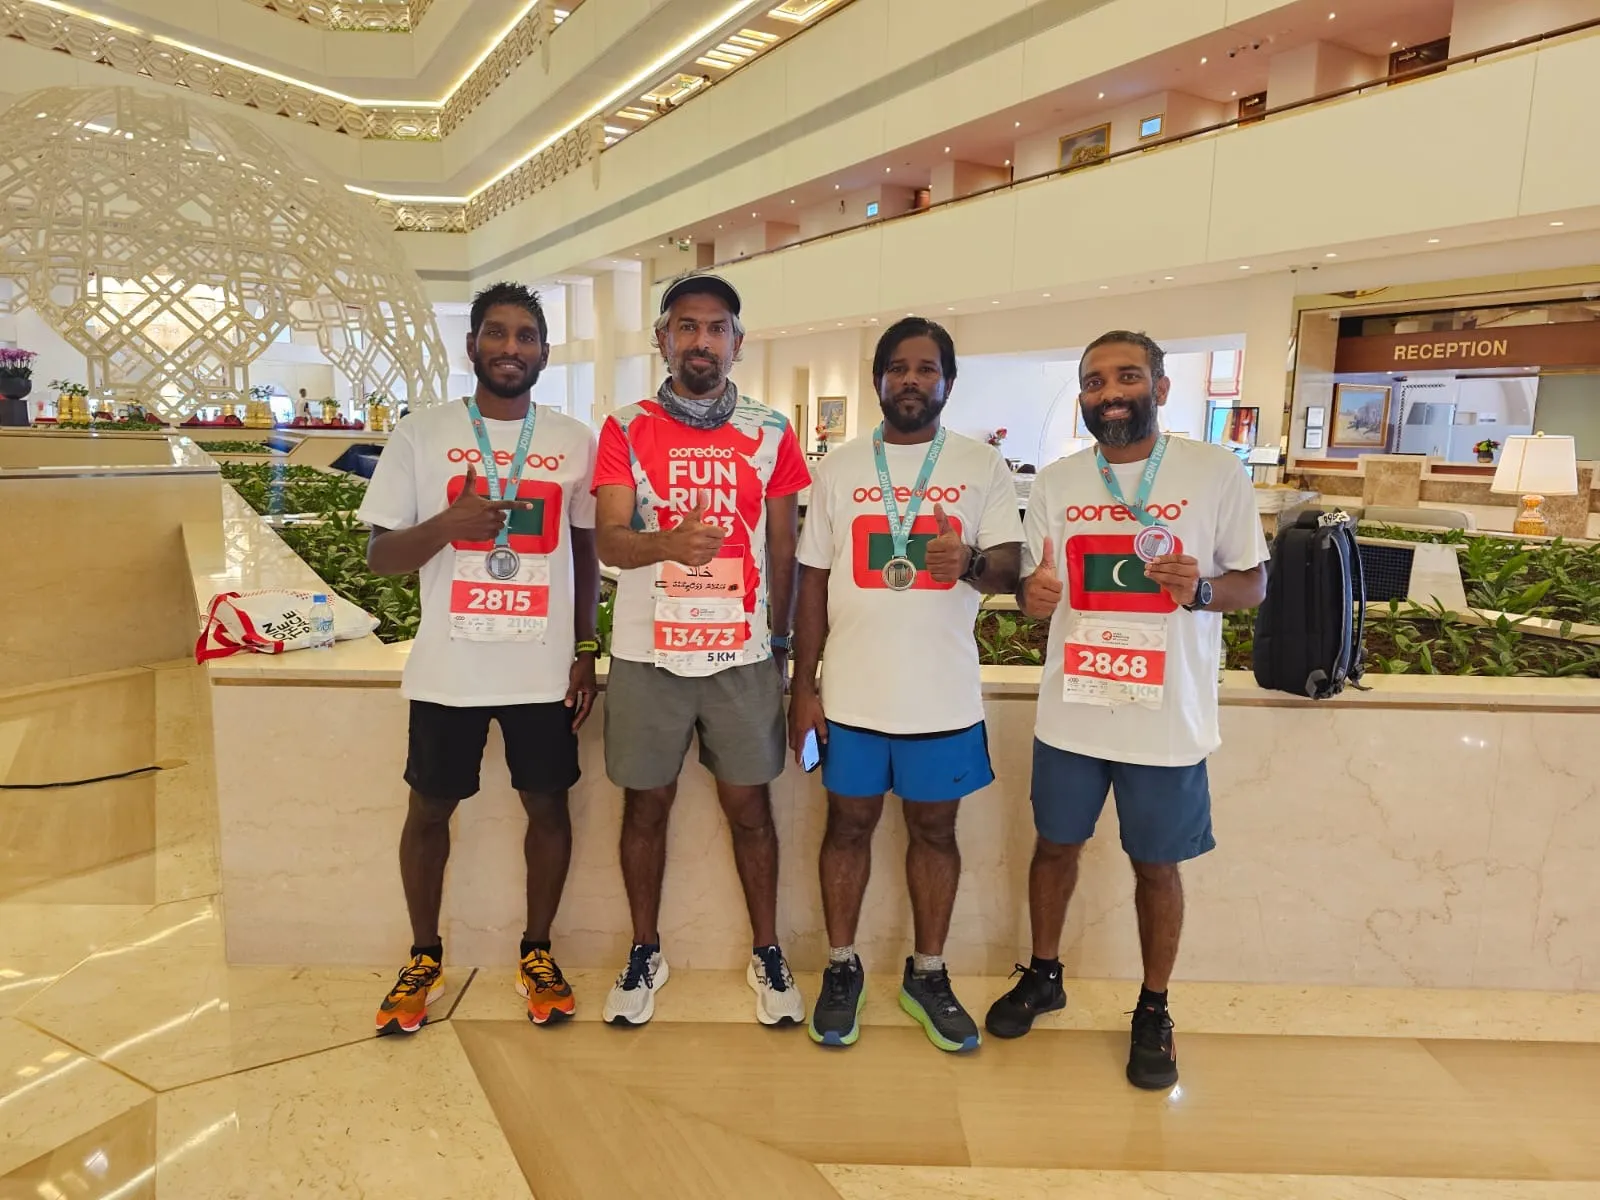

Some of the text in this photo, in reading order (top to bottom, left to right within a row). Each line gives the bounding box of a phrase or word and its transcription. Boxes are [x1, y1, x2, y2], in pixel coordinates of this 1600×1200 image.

[1394, 339, 1508, 361] RECEPTION
[519, 431, 532, 451] JOIN
[669, 444, 736, 458] ooredoo
[447, 448, 565, 471] ooeoo
[928, 445, 940, 463] JOIN
[484, 454, 501, 500] JOIN THE
[668, 460, 737, 486] FUN
[1144, 463, 1157, 484] JOIN
[668, 487, 737, 513] RUN
[853, 484, 966, 503] ooeoo
[879, 470, 899, 536] JOIN THE RACE
[669, 515, 734, 538] 23
[467, 588, 531, 612] 2815
[262, 622, 293, 641] JOIN
[276, 621, 304, 638] THE
[662, 627, 736, 647] 13473
[707, 652, 736, 662] 5 KM
[1078, 650, 1147, 678] 2868
